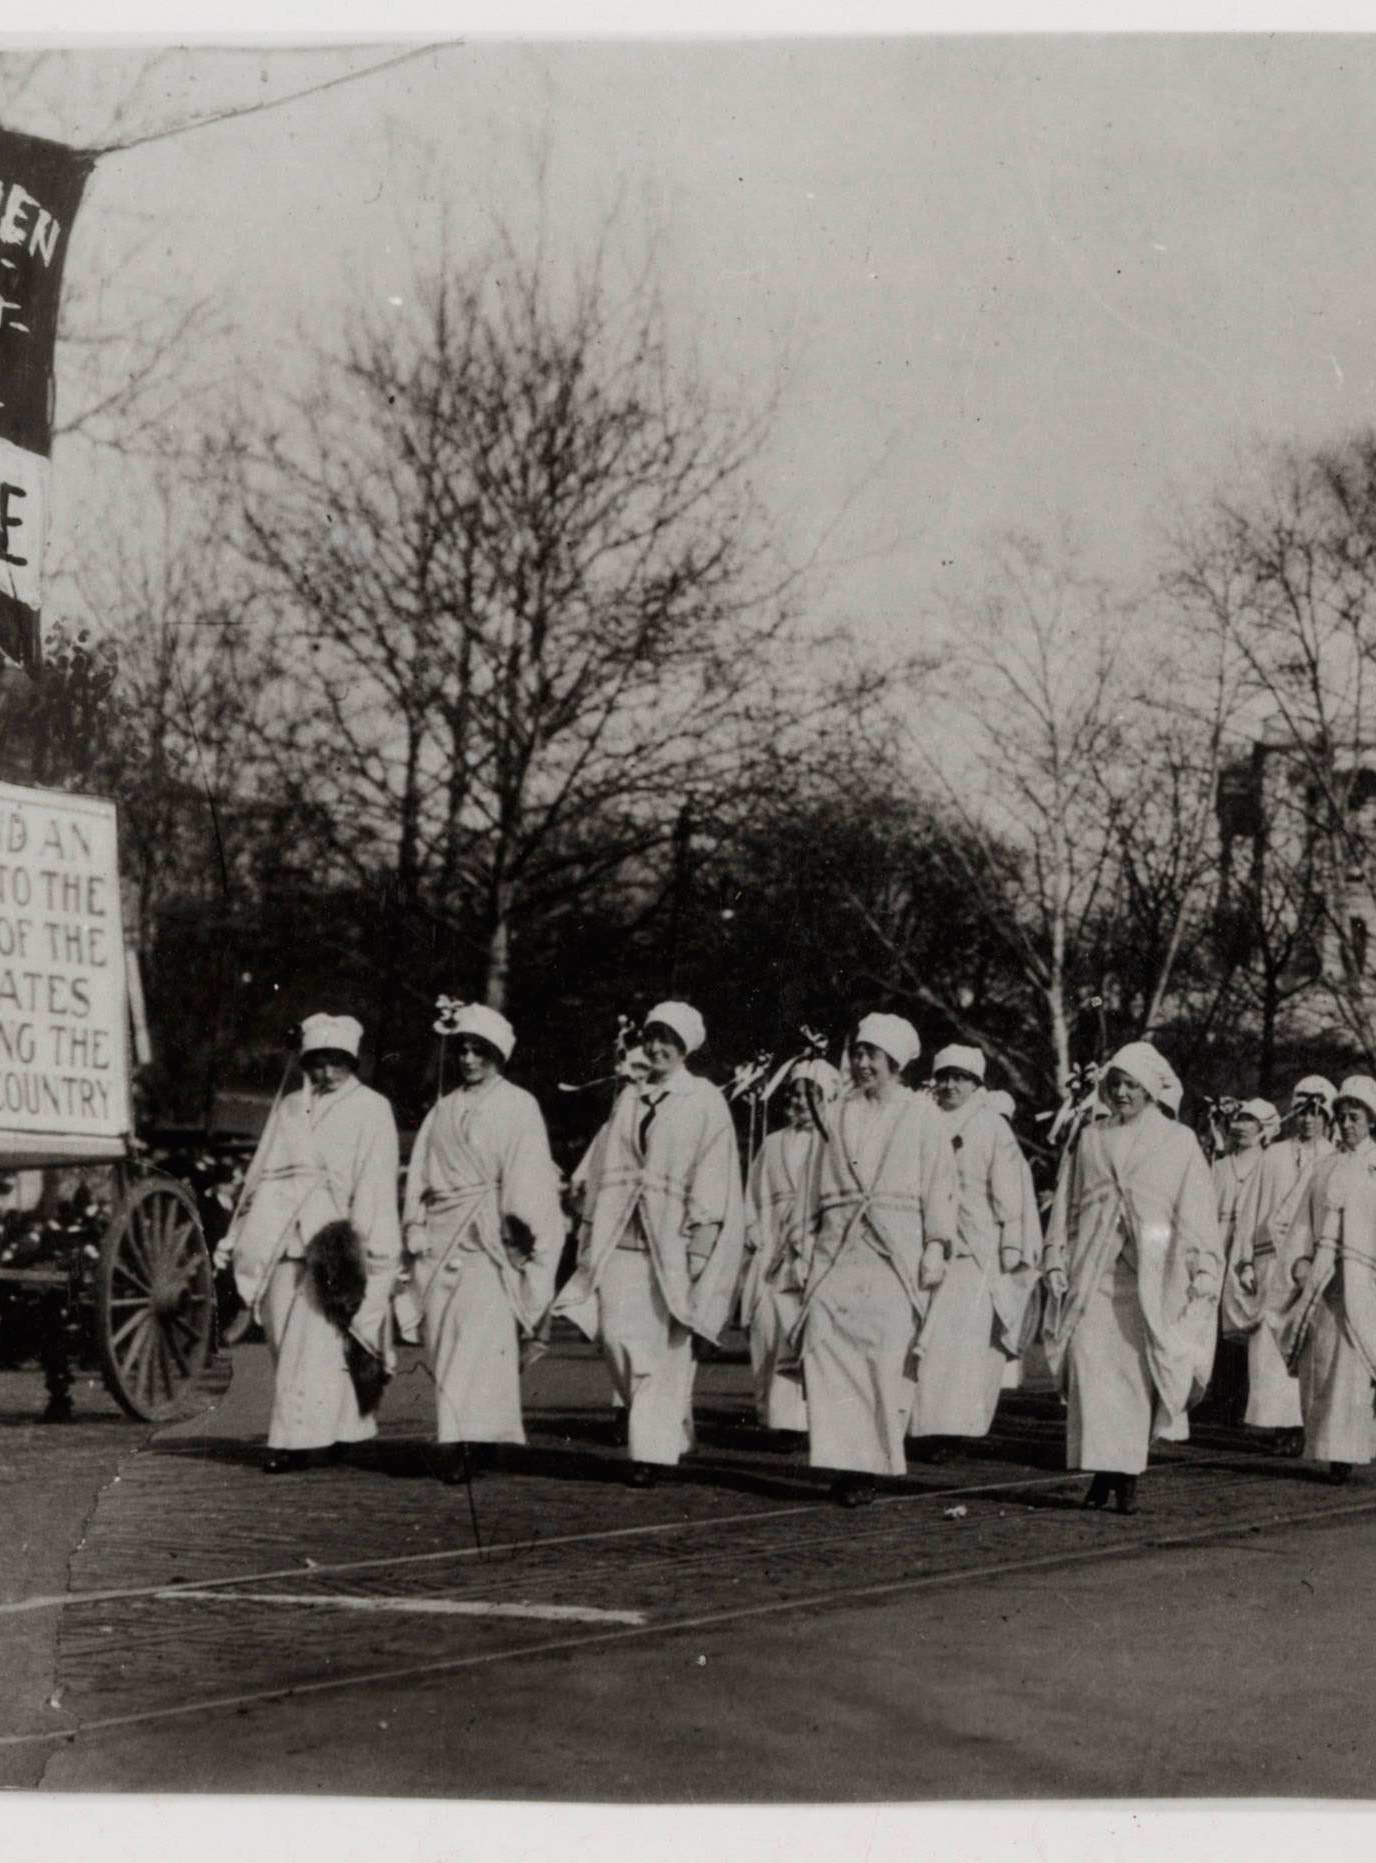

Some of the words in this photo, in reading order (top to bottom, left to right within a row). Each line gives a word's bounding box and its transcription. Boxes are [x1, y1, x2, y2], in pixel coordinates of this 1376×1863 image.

[40, 819, 93, 860] AN
[40, 870, 106, 918] THE
[44, 921, 109, 968] THE
[49, 1025, 111, 1071] THE
